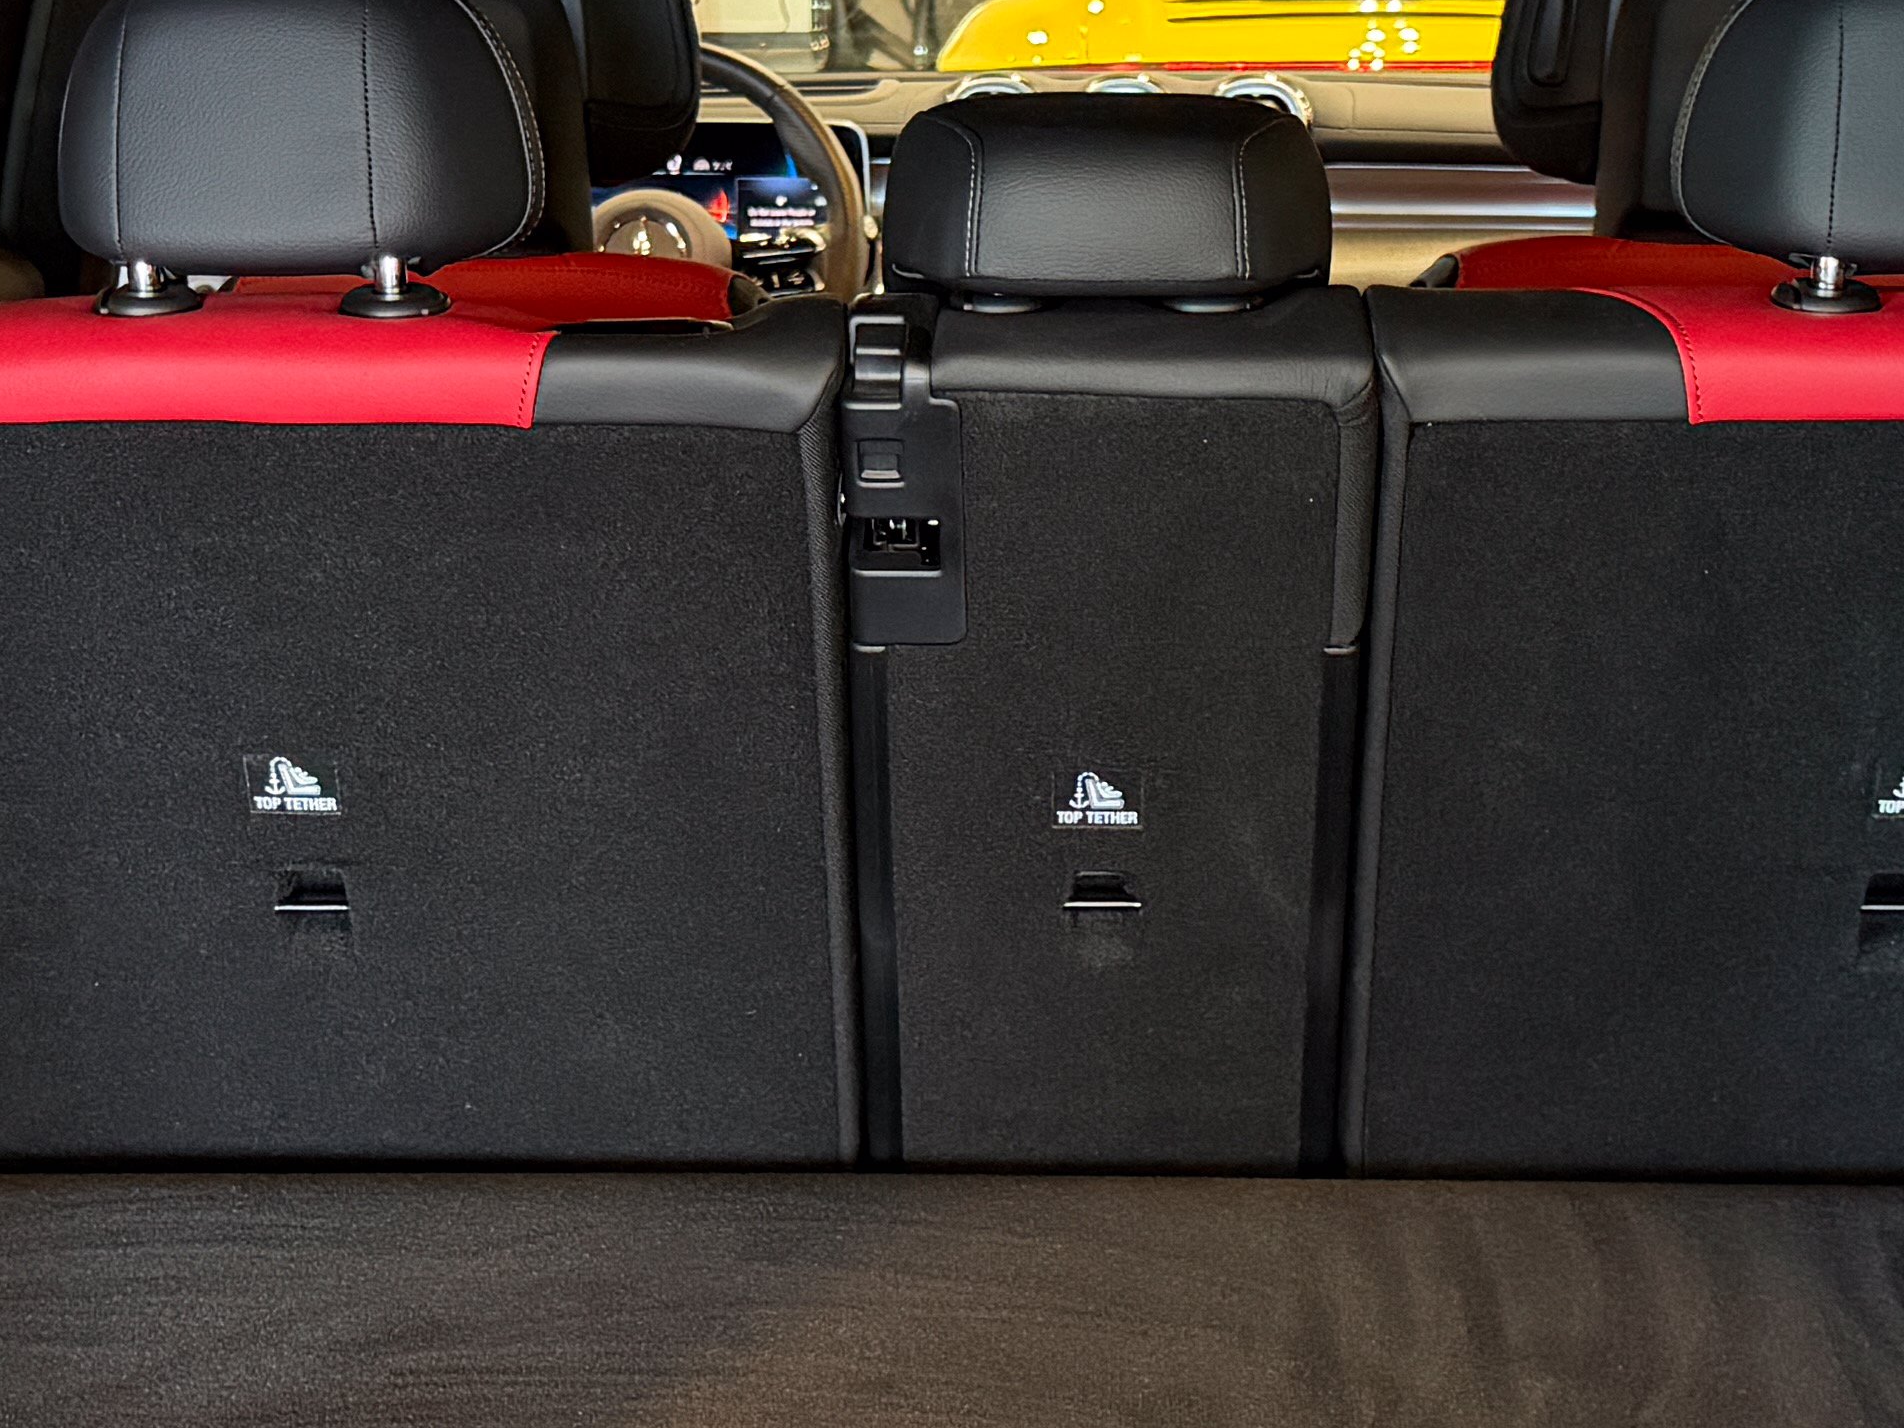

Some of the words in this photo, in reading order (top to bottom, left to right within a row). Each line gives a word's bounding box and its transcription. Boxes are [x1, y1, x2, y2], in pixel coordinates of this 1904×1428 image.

[253, 796, 281, 810] TOP
[283, 797, 338, 811] TETHER
[1056, 811, 1084, 824] TOP
[1085, 811, 1138, 824] TETHER
